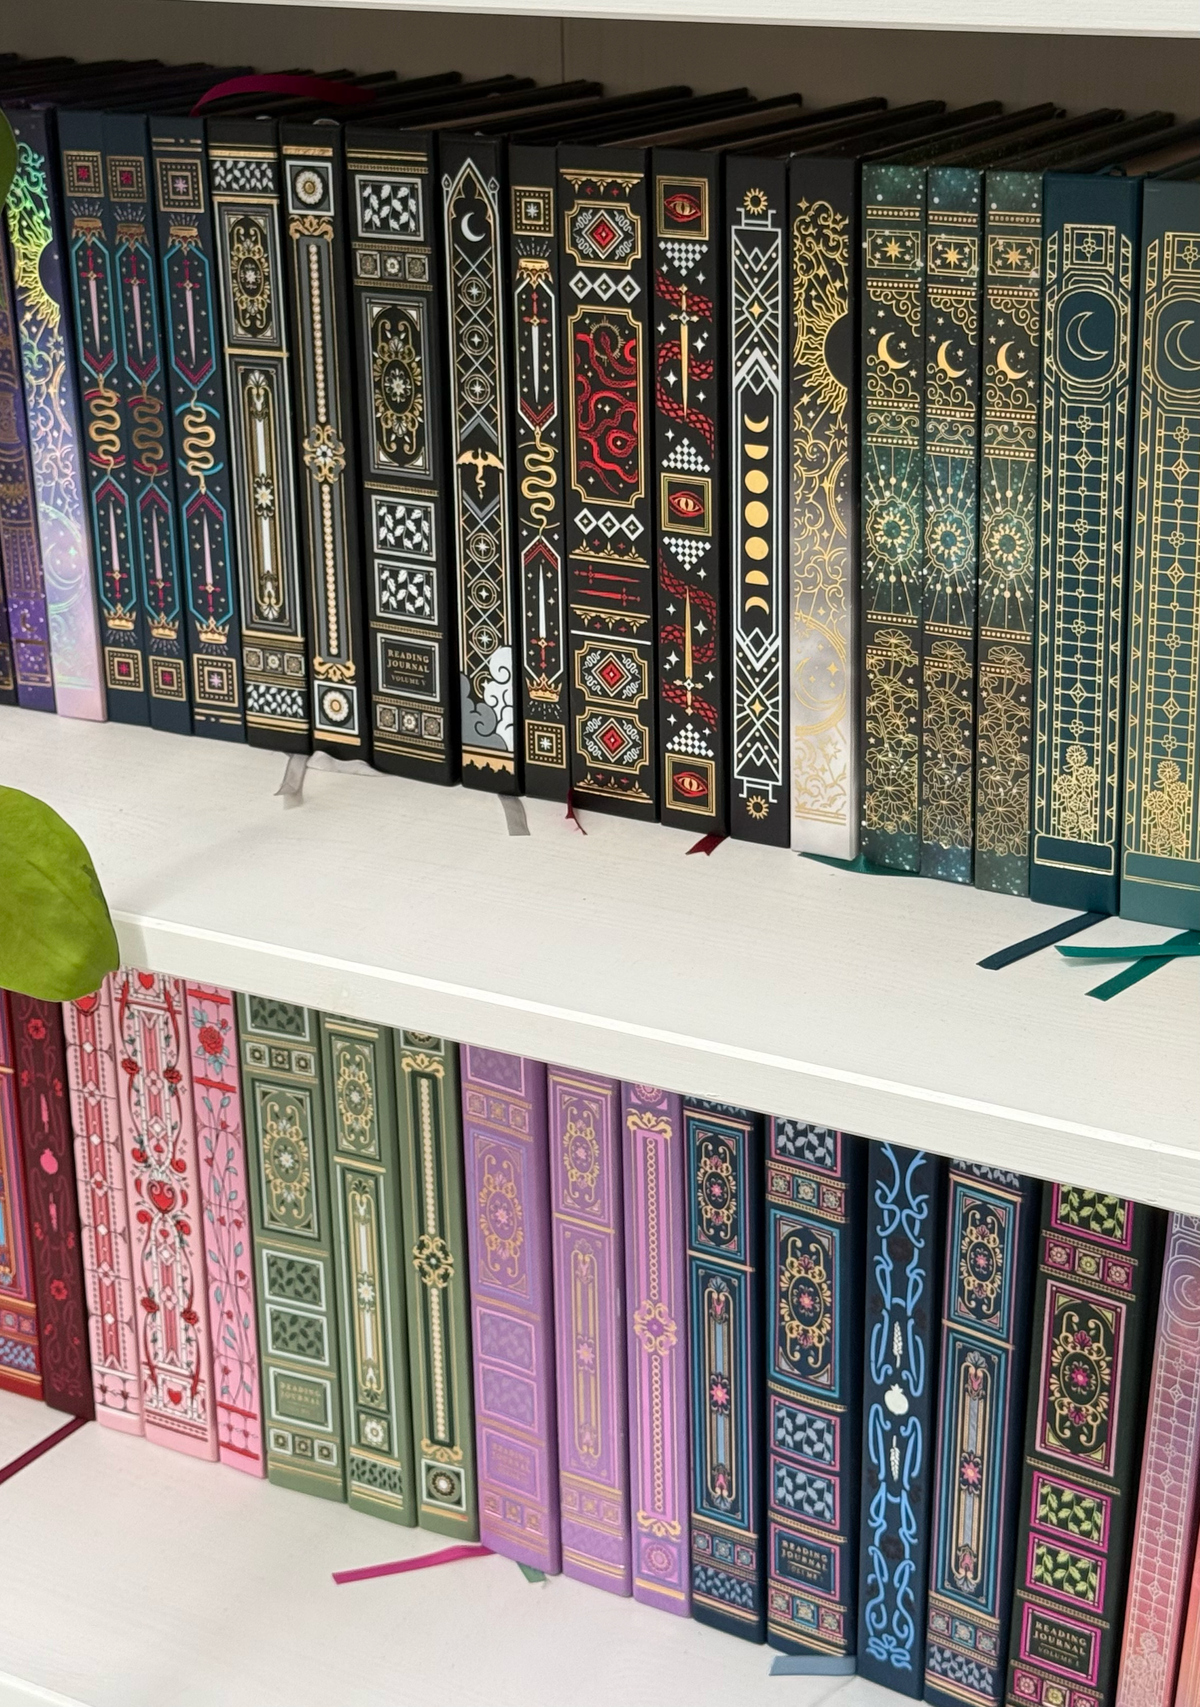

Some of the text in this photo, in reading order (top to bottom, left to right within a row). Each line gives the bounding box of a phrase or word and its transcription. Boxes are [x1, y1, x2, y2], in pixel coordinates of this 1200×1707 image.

[386, 659, 430, 673] JOURNAL
[387, 649, 430, 664] READING
[391, 674, 420, 686] VOLUME
[781, 1539, 828, 1563] READING
[781, 1548, 828, 1571] JOURNAL
[1033, 1630, 1086, 1656] JOURNAL
[1035, 1620, 1087, 1646] READING
[1038, 1646, 1072, 1664] VOLUME
